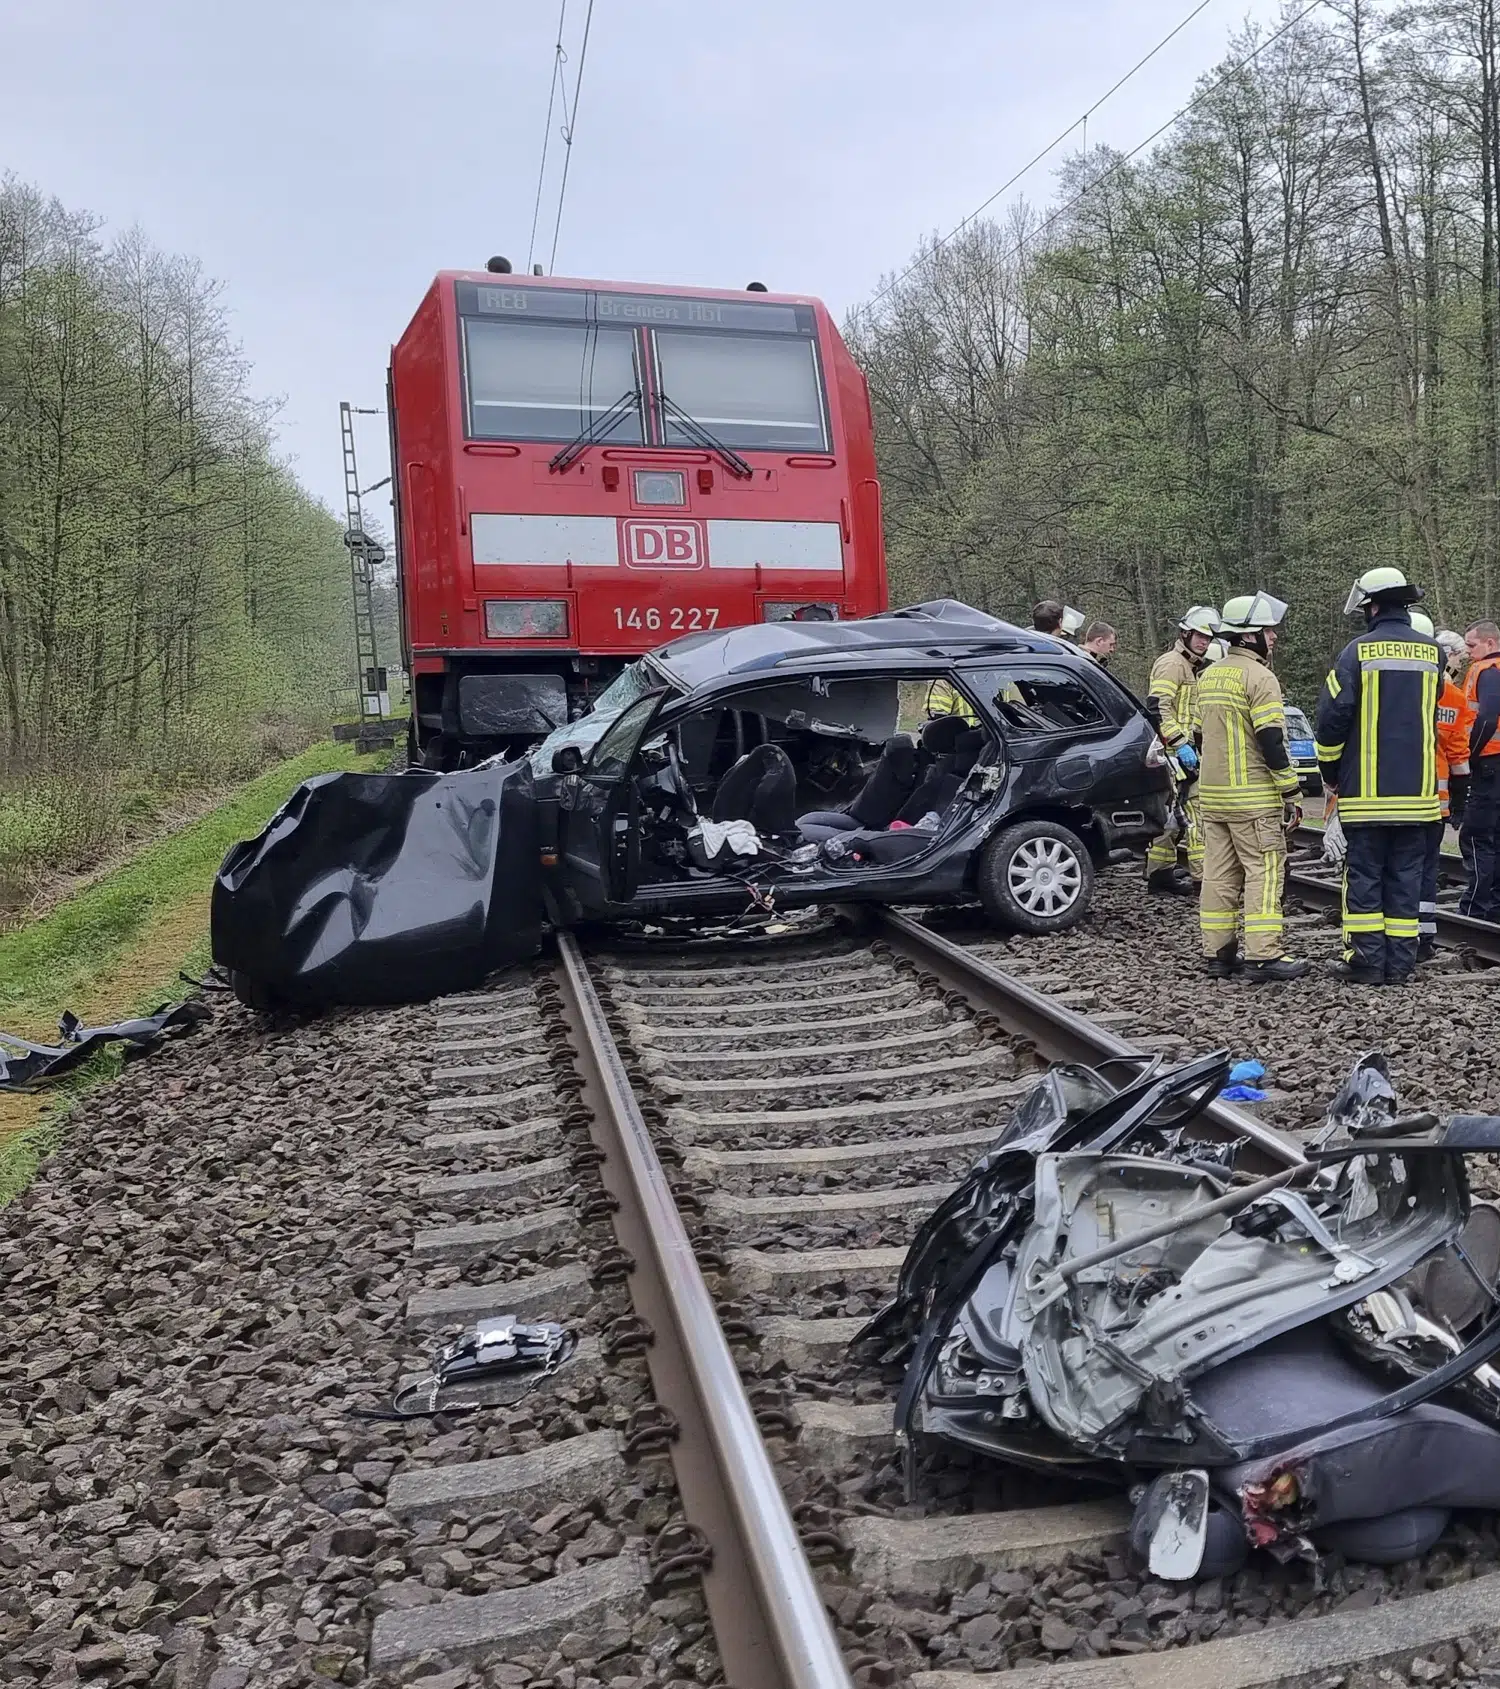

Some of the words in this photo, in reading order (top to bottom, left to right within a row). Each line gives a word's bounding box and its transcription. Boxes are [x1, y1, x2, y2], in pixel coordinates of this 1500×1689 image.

[599, 299, 679, 321] Bremen
[635, 528, 693, 560] DB
[613, 607, 661, 630] 146
[669, 607, 720, 630] 227
[1361, 643, 1436, 661] FEUERWEHR
